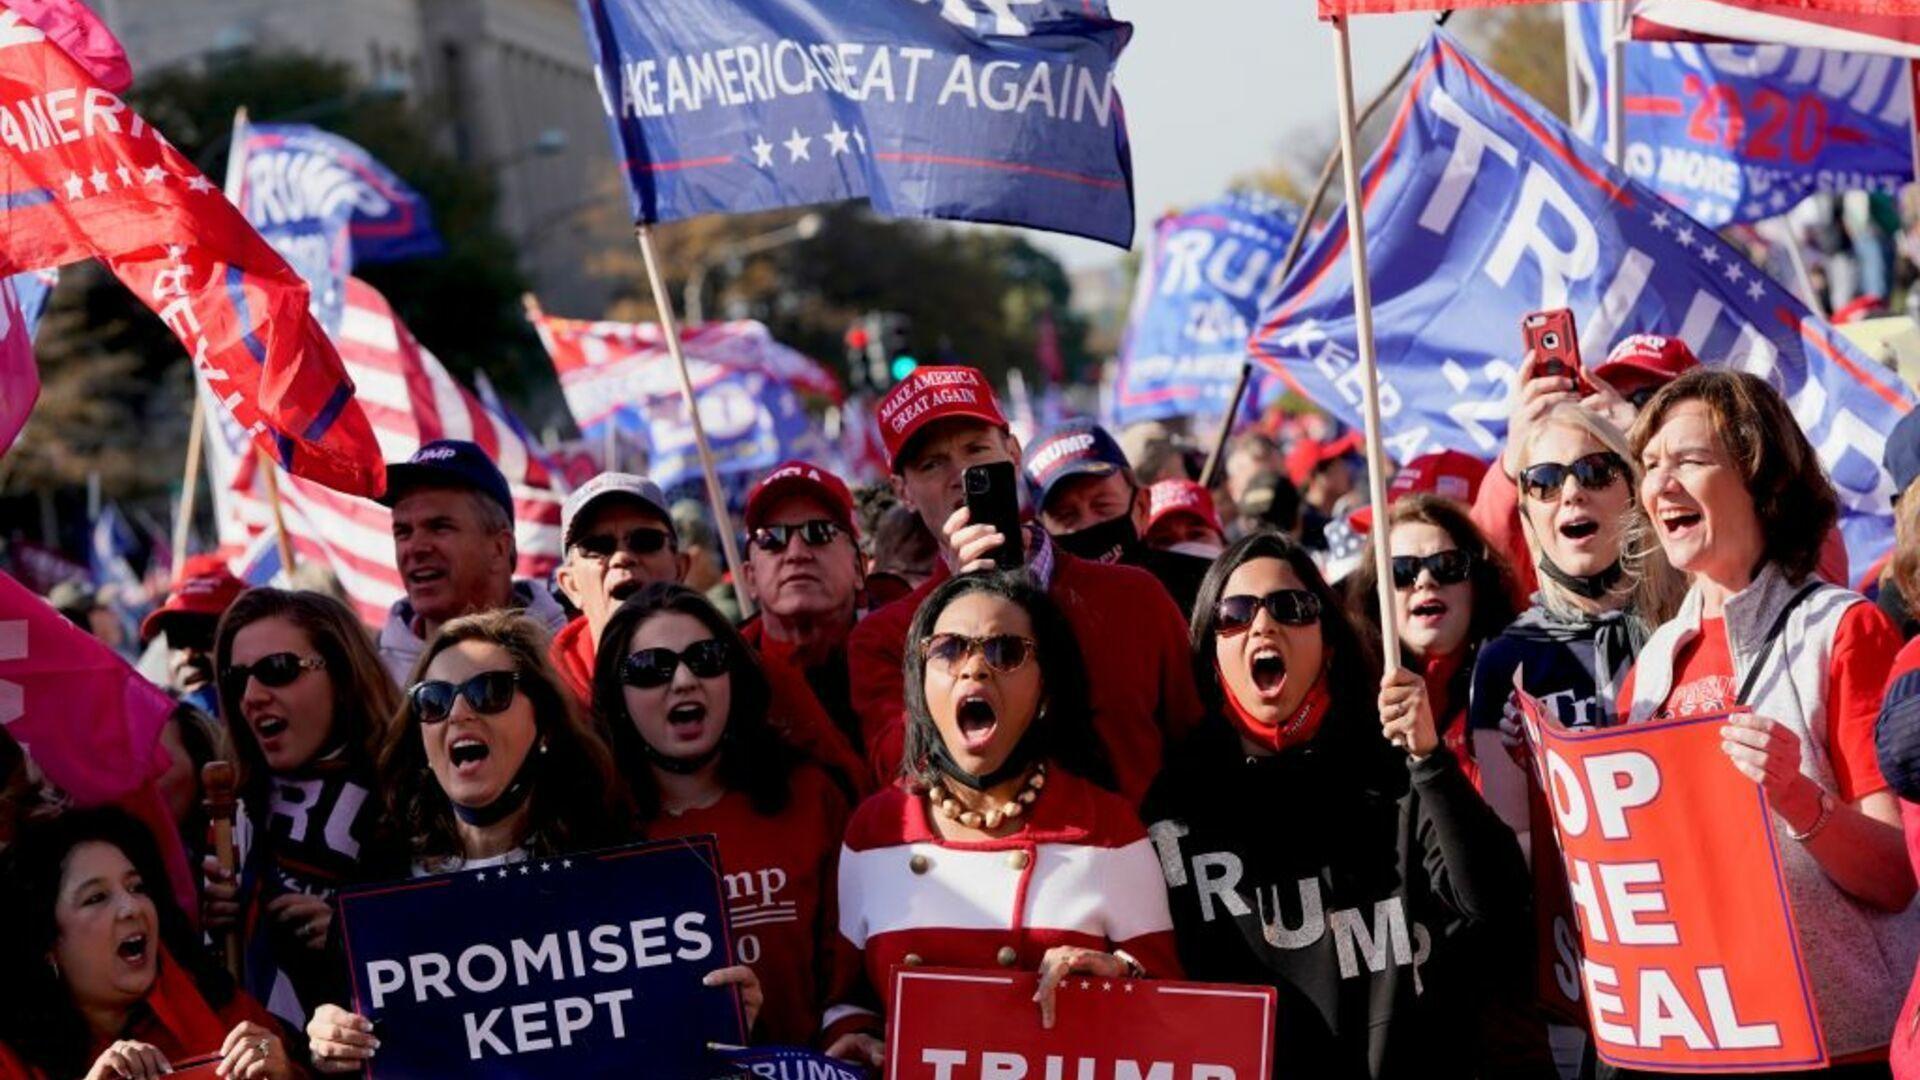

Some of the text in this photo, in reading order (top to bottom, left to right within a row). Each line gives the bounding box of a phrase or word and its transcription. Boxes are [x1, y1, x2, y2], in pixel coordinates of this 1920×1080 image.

[667, 38, 829, 113] AMERICA
[937, 54, 1114, 127] AGAIN
[1160, 229, 1275, 300] RU
[881, 370, 980, 423] MAKE AMERICA
[891, 387, 977, 434] GREAT AGAIN
[1026, 433, 1096, 479] TRUMP
[1148, 819, 1432, 996] TRUMP
[366, 911, 713, 1009] PROMISES
[463, 989, 634, 1060] KEPT
